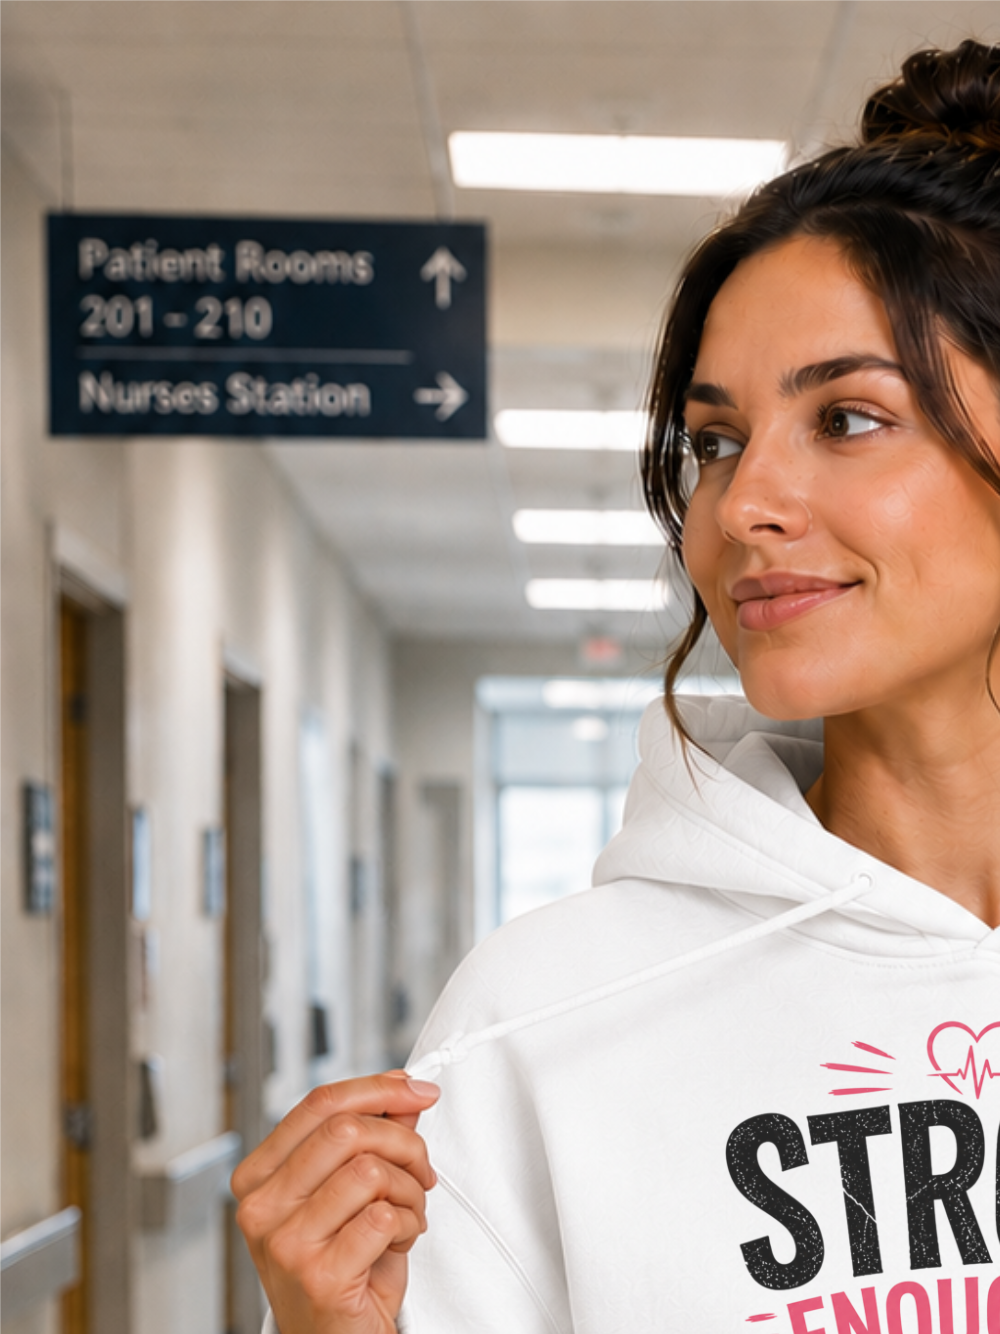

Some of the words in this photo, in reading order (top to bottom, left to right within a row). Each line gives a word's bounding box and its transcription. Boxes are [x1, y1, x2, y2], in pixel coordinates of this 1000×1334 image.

[79, 238, 224, 281] Patient
[235, 241, 374, 285] Rooms
[79, 295, 154, 337] 201
[195, 296, 273, 339] 210
[79, 371, 219, 414] Nurses
[226, 372, 372, 417] Station
